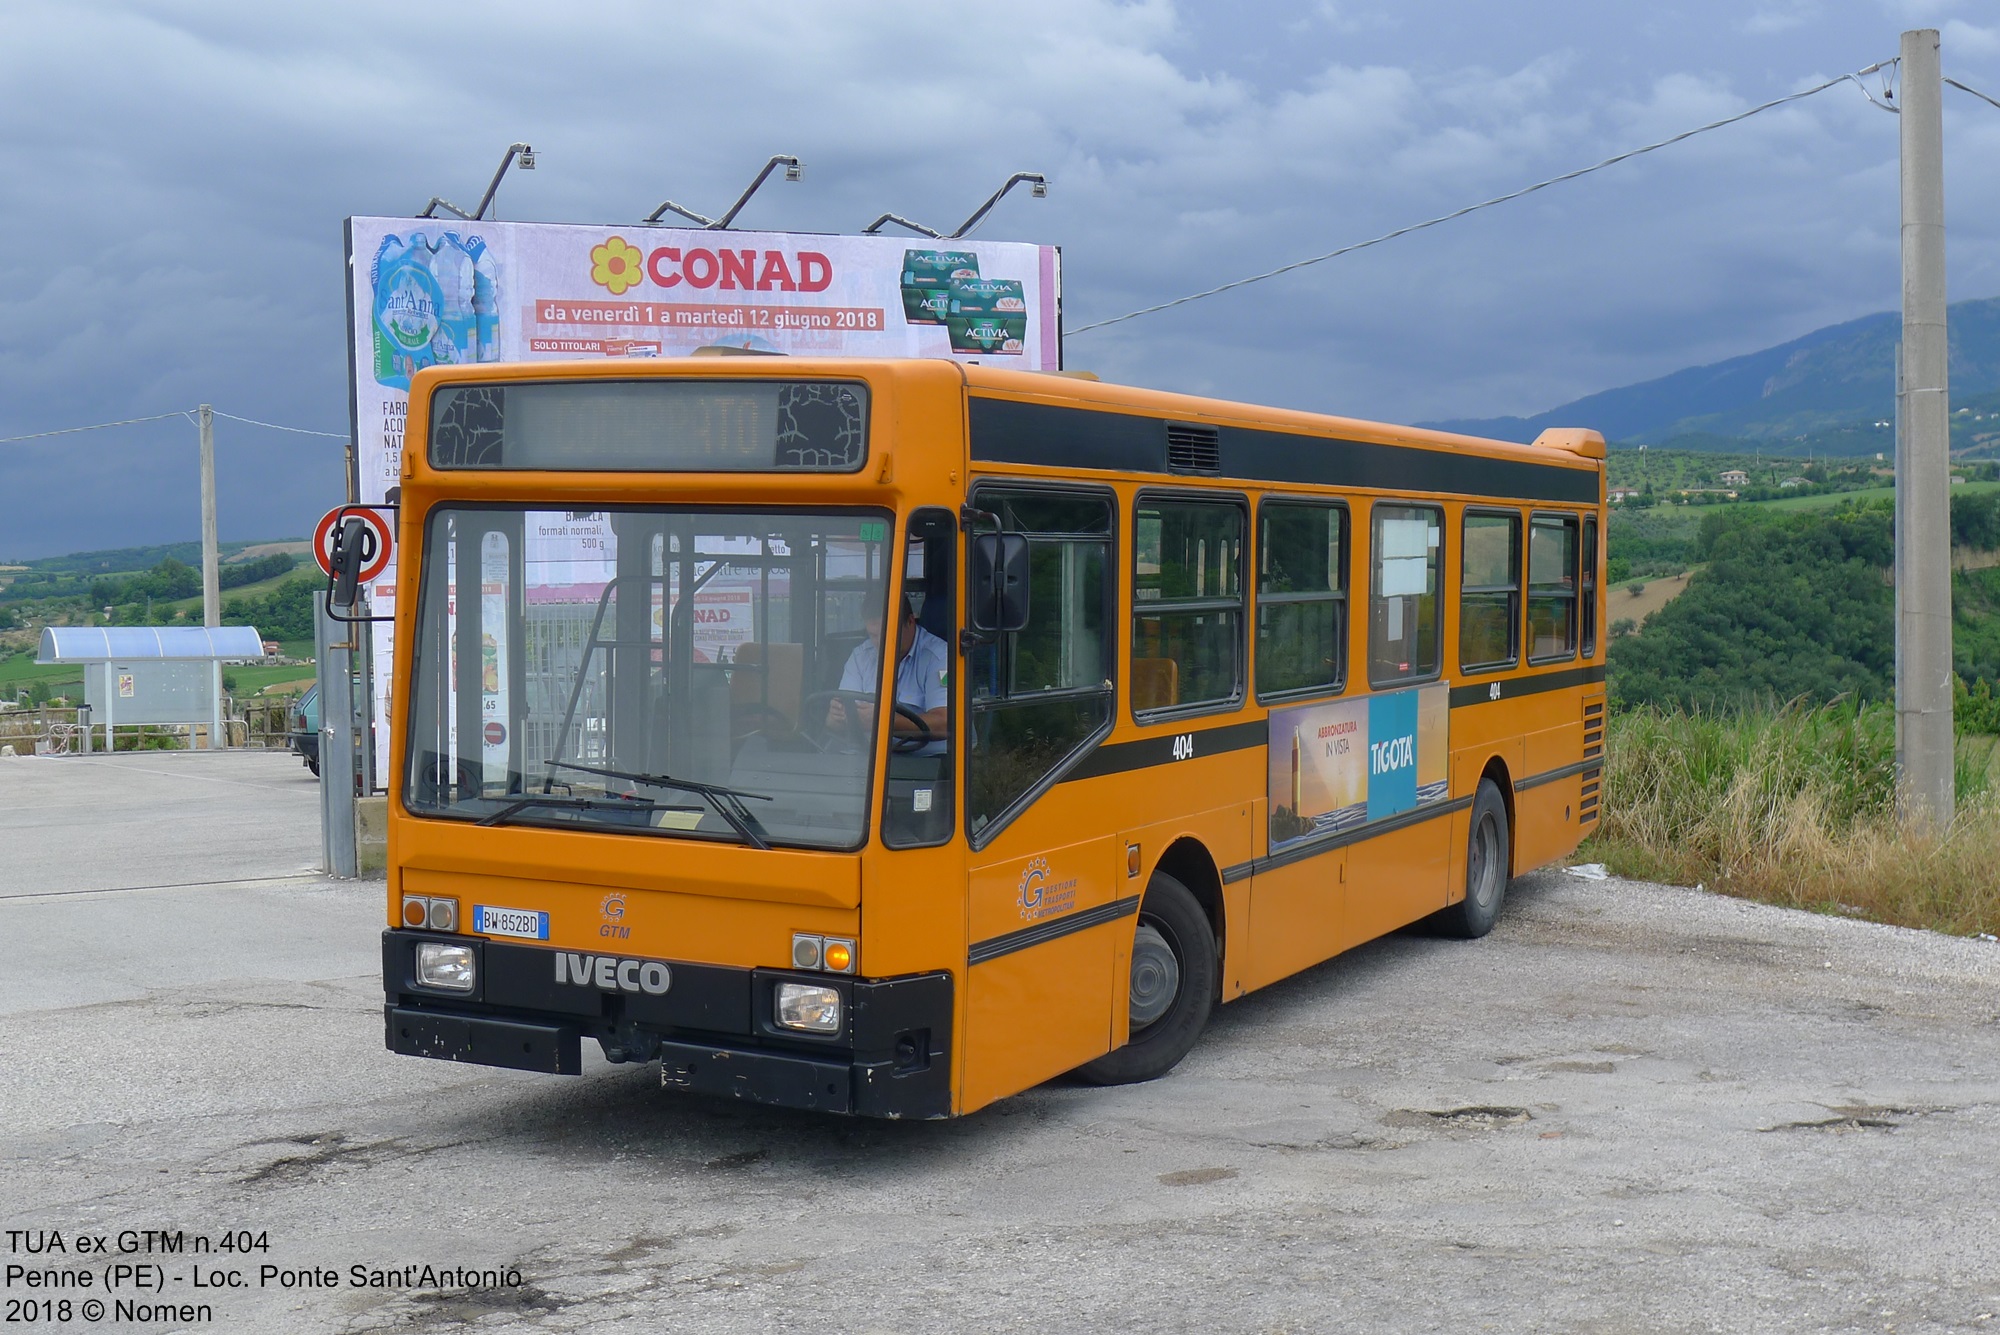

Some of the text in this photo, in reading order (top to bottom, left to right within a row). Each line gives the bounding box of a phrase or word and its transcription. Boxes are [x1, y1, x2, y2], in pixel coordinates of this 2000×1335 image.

[915, 255, 968, 264] ACTIVIA
[647, 247, 833, 292] CONAD
[960, 283, 1013, 292] ACTIVIA
[380, 287, 441, 318] Sant'Anna
[544, 304, 877, 329] da venerdì 1 a martedì 12 giugno 2018
[965, 327, 1010, 338] ACTIVIA
[534, 341, 558, 351] SOLO
[560, 341, 600, 352] TITOLARI
[384, 434, 405, 449] NAT
[538, 525, 604, 536] formati normali,
[582, 538, 605, 551] 500 g
[1489, 682, 1501, 701] 404
[1317, 720, 1358, 740] ABBRONZATURA
[1172, 734, 1193, 761] 404
[1325, 737, 1351, 757] IN VISTA
[1045, 879, 1077, 894] GESTIONE
[1044, 890, 1076, 906] TRASPORTI
[600, 924, 631, 940] GTM
[554, 952, 671, 995] IVECO
